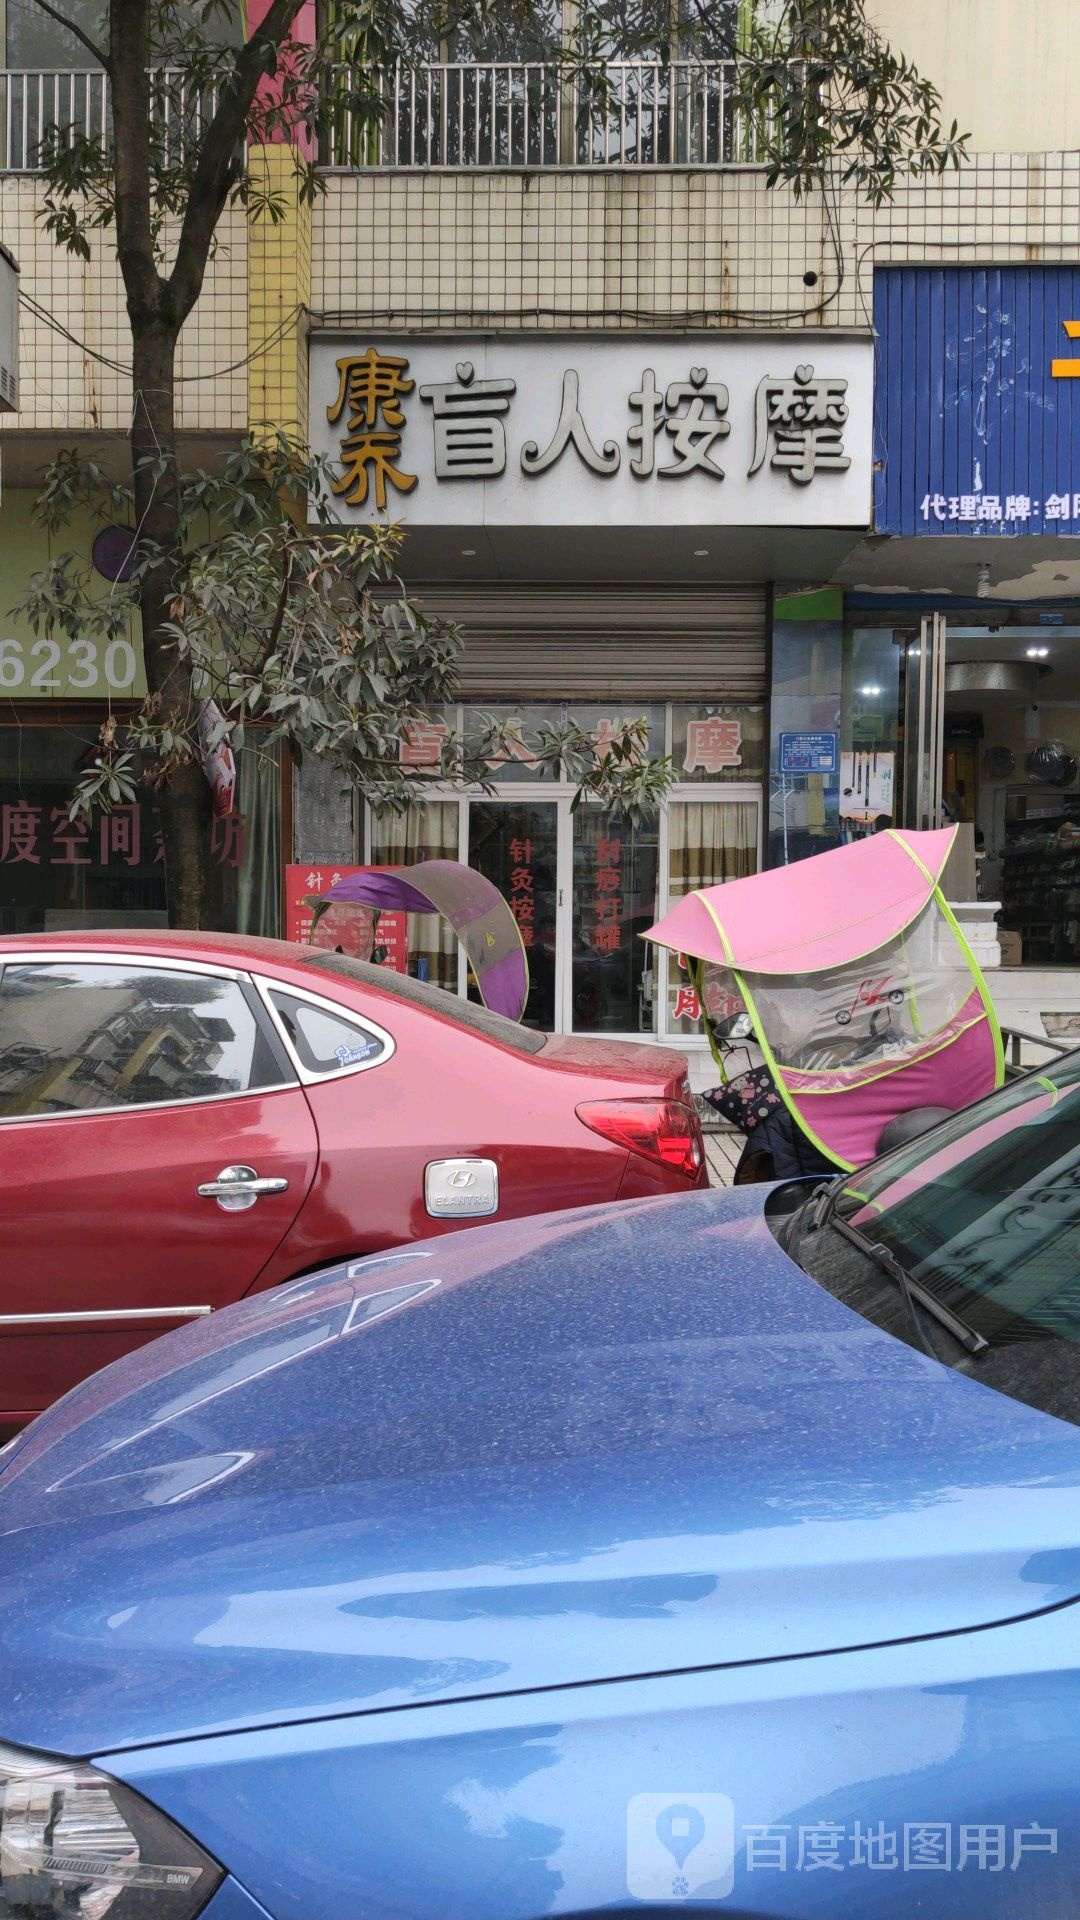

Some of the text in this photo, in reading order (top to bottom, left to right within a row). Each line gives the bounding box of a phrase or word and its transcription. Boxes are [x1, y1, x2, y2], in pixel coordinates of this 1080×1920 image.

[418, 361, 852, 486] 盲人按摩
[920, 493, 1080, 522] 代理品牌:剑
[0, 639, 137, 688] 6230
[434, 1194, 490, 1207] ELANTRA
[166, 1873, 190, 1885] BMW
